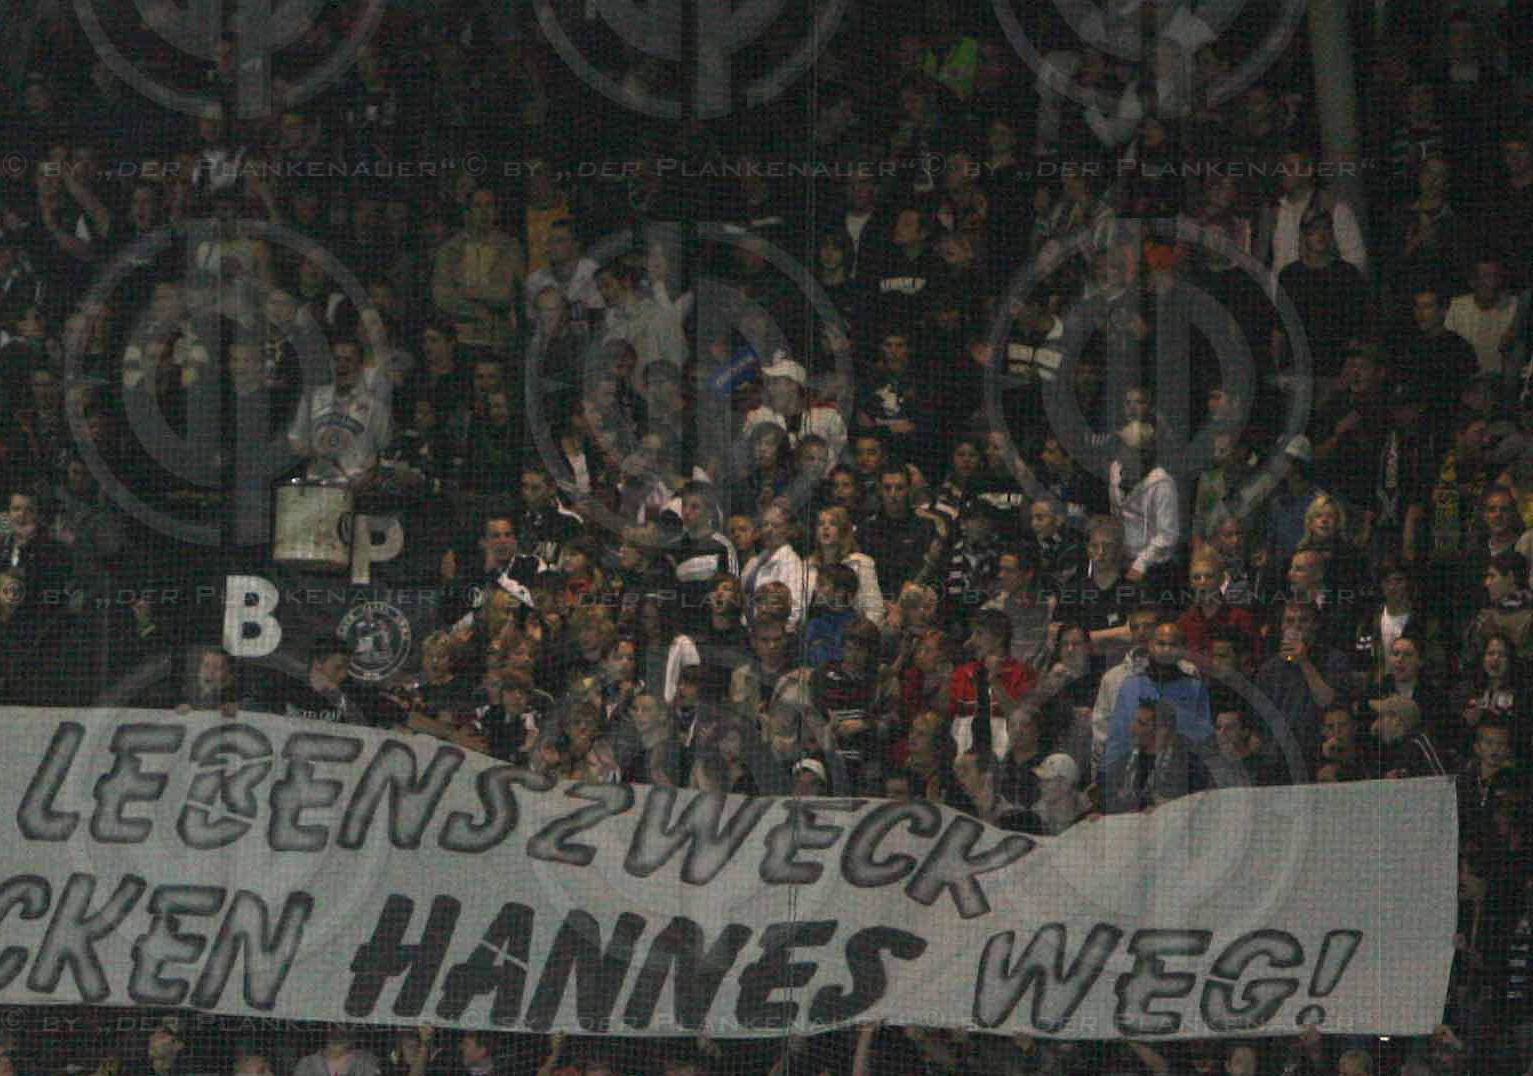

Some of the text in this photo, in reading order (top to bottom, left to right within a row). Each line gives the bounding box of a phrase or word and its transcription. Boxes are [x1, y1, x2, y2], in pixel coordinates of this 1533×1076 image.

[223, 575, 282, 656] B
[17, 721, 1037, 919] LEBENSZWECK
[344, 893, 928, 1034] HANNES
[971, 922, 1363, 1035] WEG!
